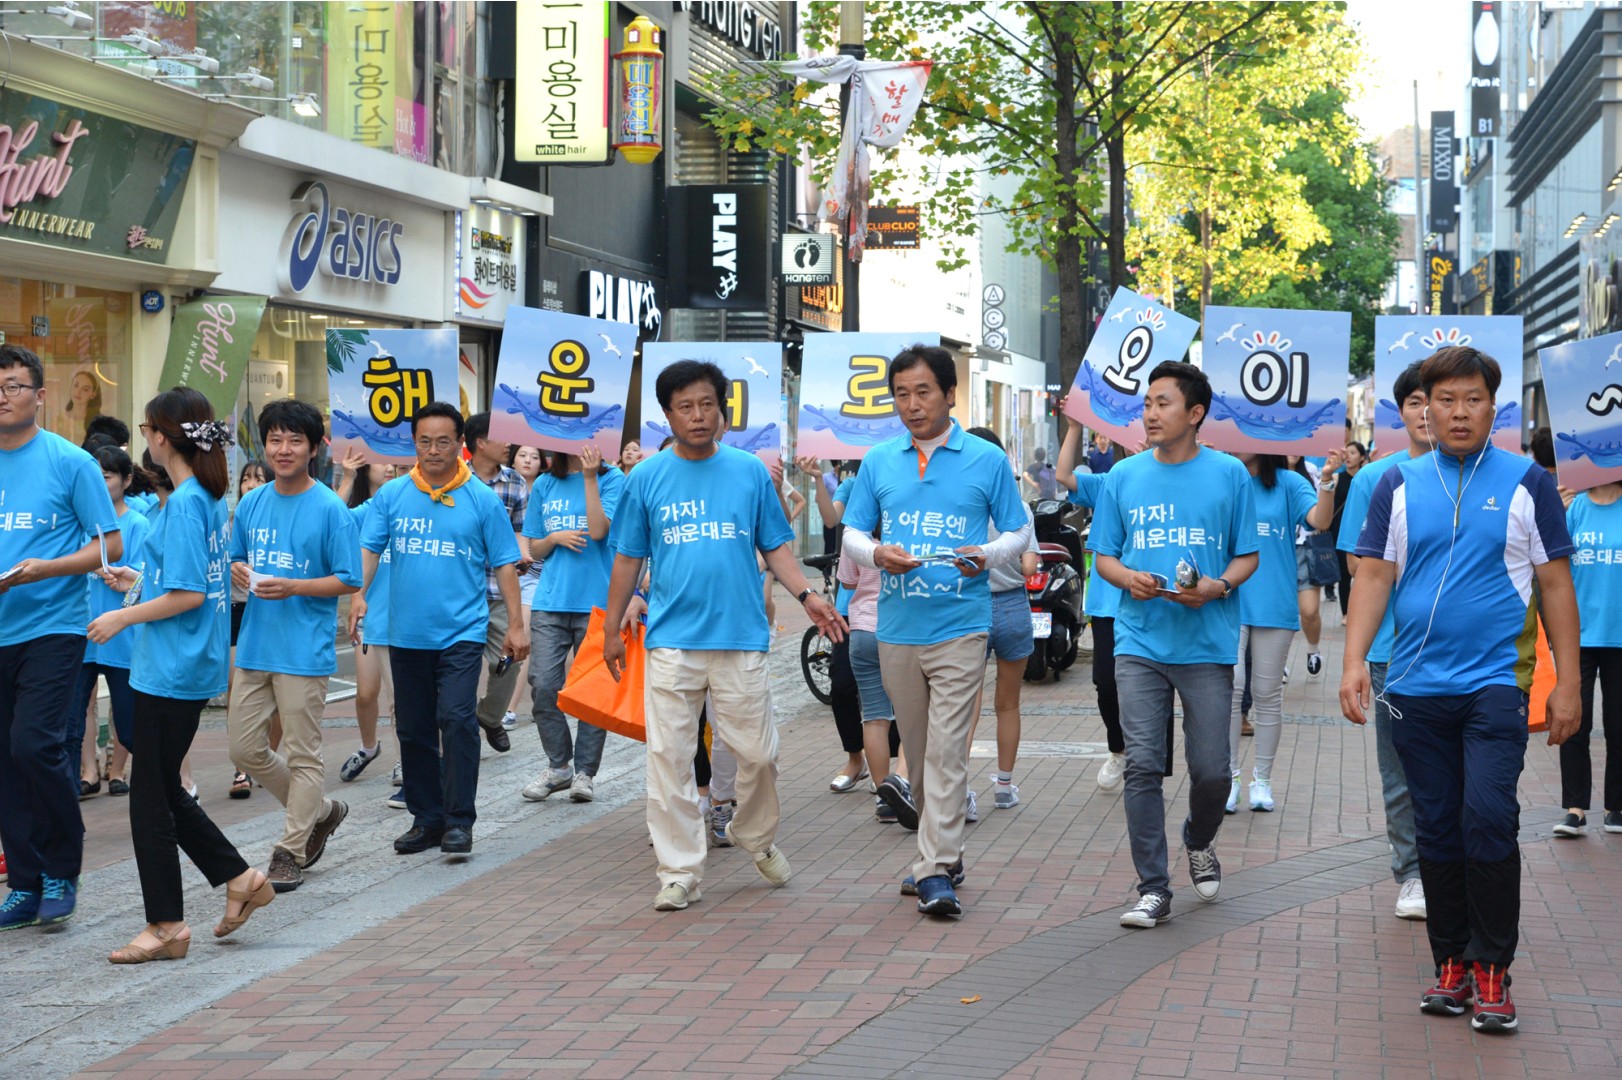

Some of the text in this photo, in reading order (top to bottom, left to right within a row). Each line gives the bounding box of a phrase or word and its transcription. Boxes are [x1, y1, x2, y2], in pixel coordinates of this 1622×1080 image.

[540, 3, 583, 140] 미용실
[1478, 118, 1493, 133] B1
[536, 144, 587, 154] white hair
[1434, 127, 1452, 180] MIXXO
[9, 208, 95, 239] INNERWEAR
[331, 206, 404, 285] asics
[474, 256, 516, 292] 화이트미용실
[1103, 326, 1153, 395] 오
[362, 356, 434, 427] 해
[537, 340, 594, 417] 운
[840, 355, 898, 418] 로
[1240, 350, 1309, 408] 이
[542, 499, 569, 515] 가자!
[660, 500, 705, 521] 가자!
[1129, 504, 1174, 525] 가자!
[395, 517, 433, 534] 가자!
[899, 510, 967, 539] 여름엔
[1133, 527, 1223, 550] 해운대로~!
[395, 537, 472, 560] 해운대로~!
